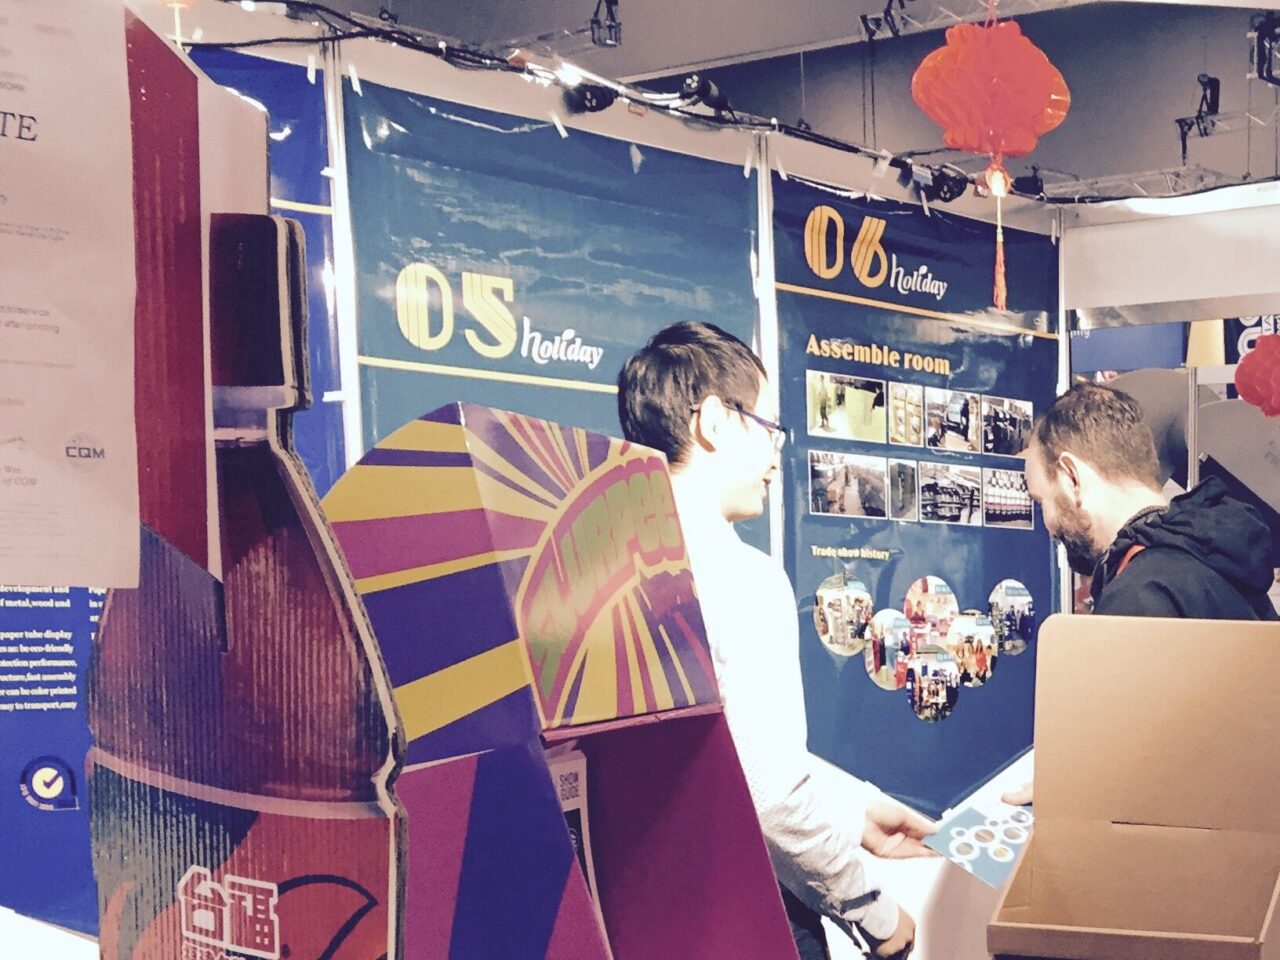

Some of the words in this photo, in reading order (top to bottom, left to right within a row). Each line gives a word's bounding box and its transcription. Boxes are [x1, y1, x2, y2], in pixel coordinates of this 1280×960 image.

[804, 205, 889, 288] 06
[890, 253, 948, 301] holiday
[396, 262, 518, 359] 05
[520, 315, 604, 370] holiday
[806, 333, 900, 370] Assemble
[903, 352, 952, 376] room
[65, 446, 105, 460] CQM
[860, 548, 890, 561] history
[54, 598, 71, 608] and
[44, 629, 73, 641] display
